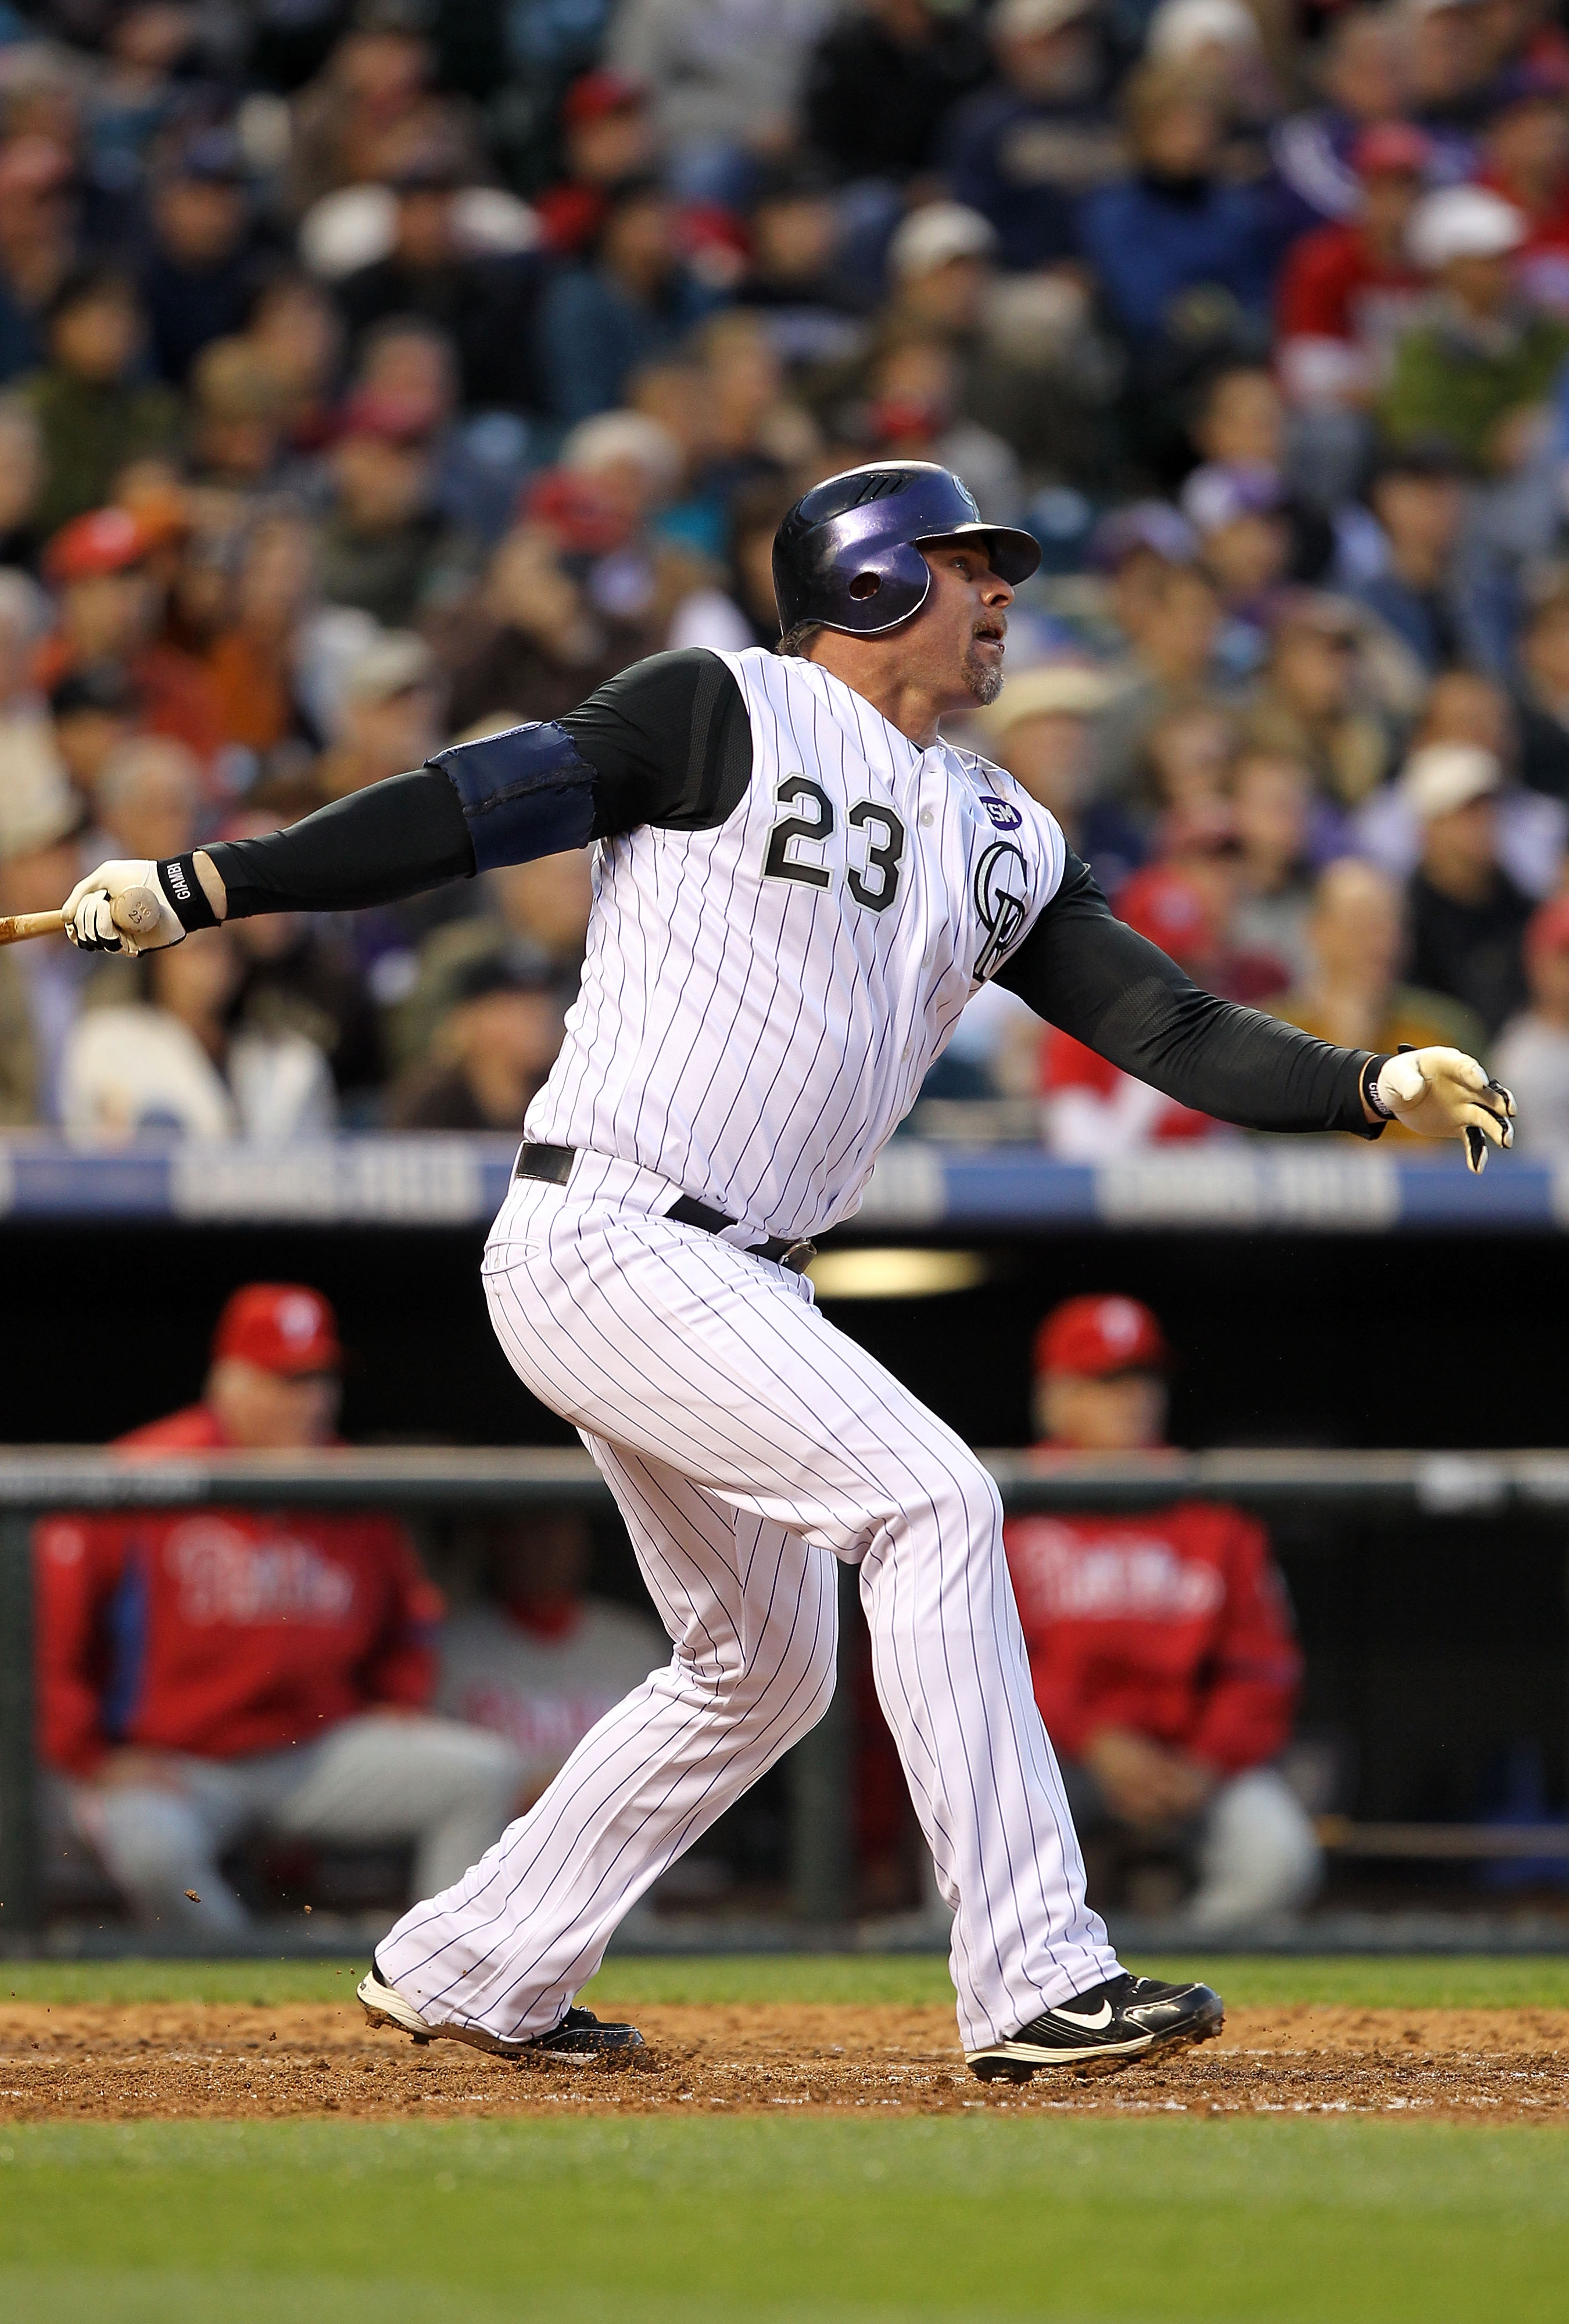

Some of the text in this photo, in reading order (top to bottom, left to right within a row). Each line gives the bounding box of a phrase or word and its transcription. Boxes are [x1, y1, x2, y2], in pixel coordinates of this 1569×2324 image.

[759, 772, 907, 917] 23
[166, 862, 191, 900] GIAMBI
[128, 910, 142, 924] 23
